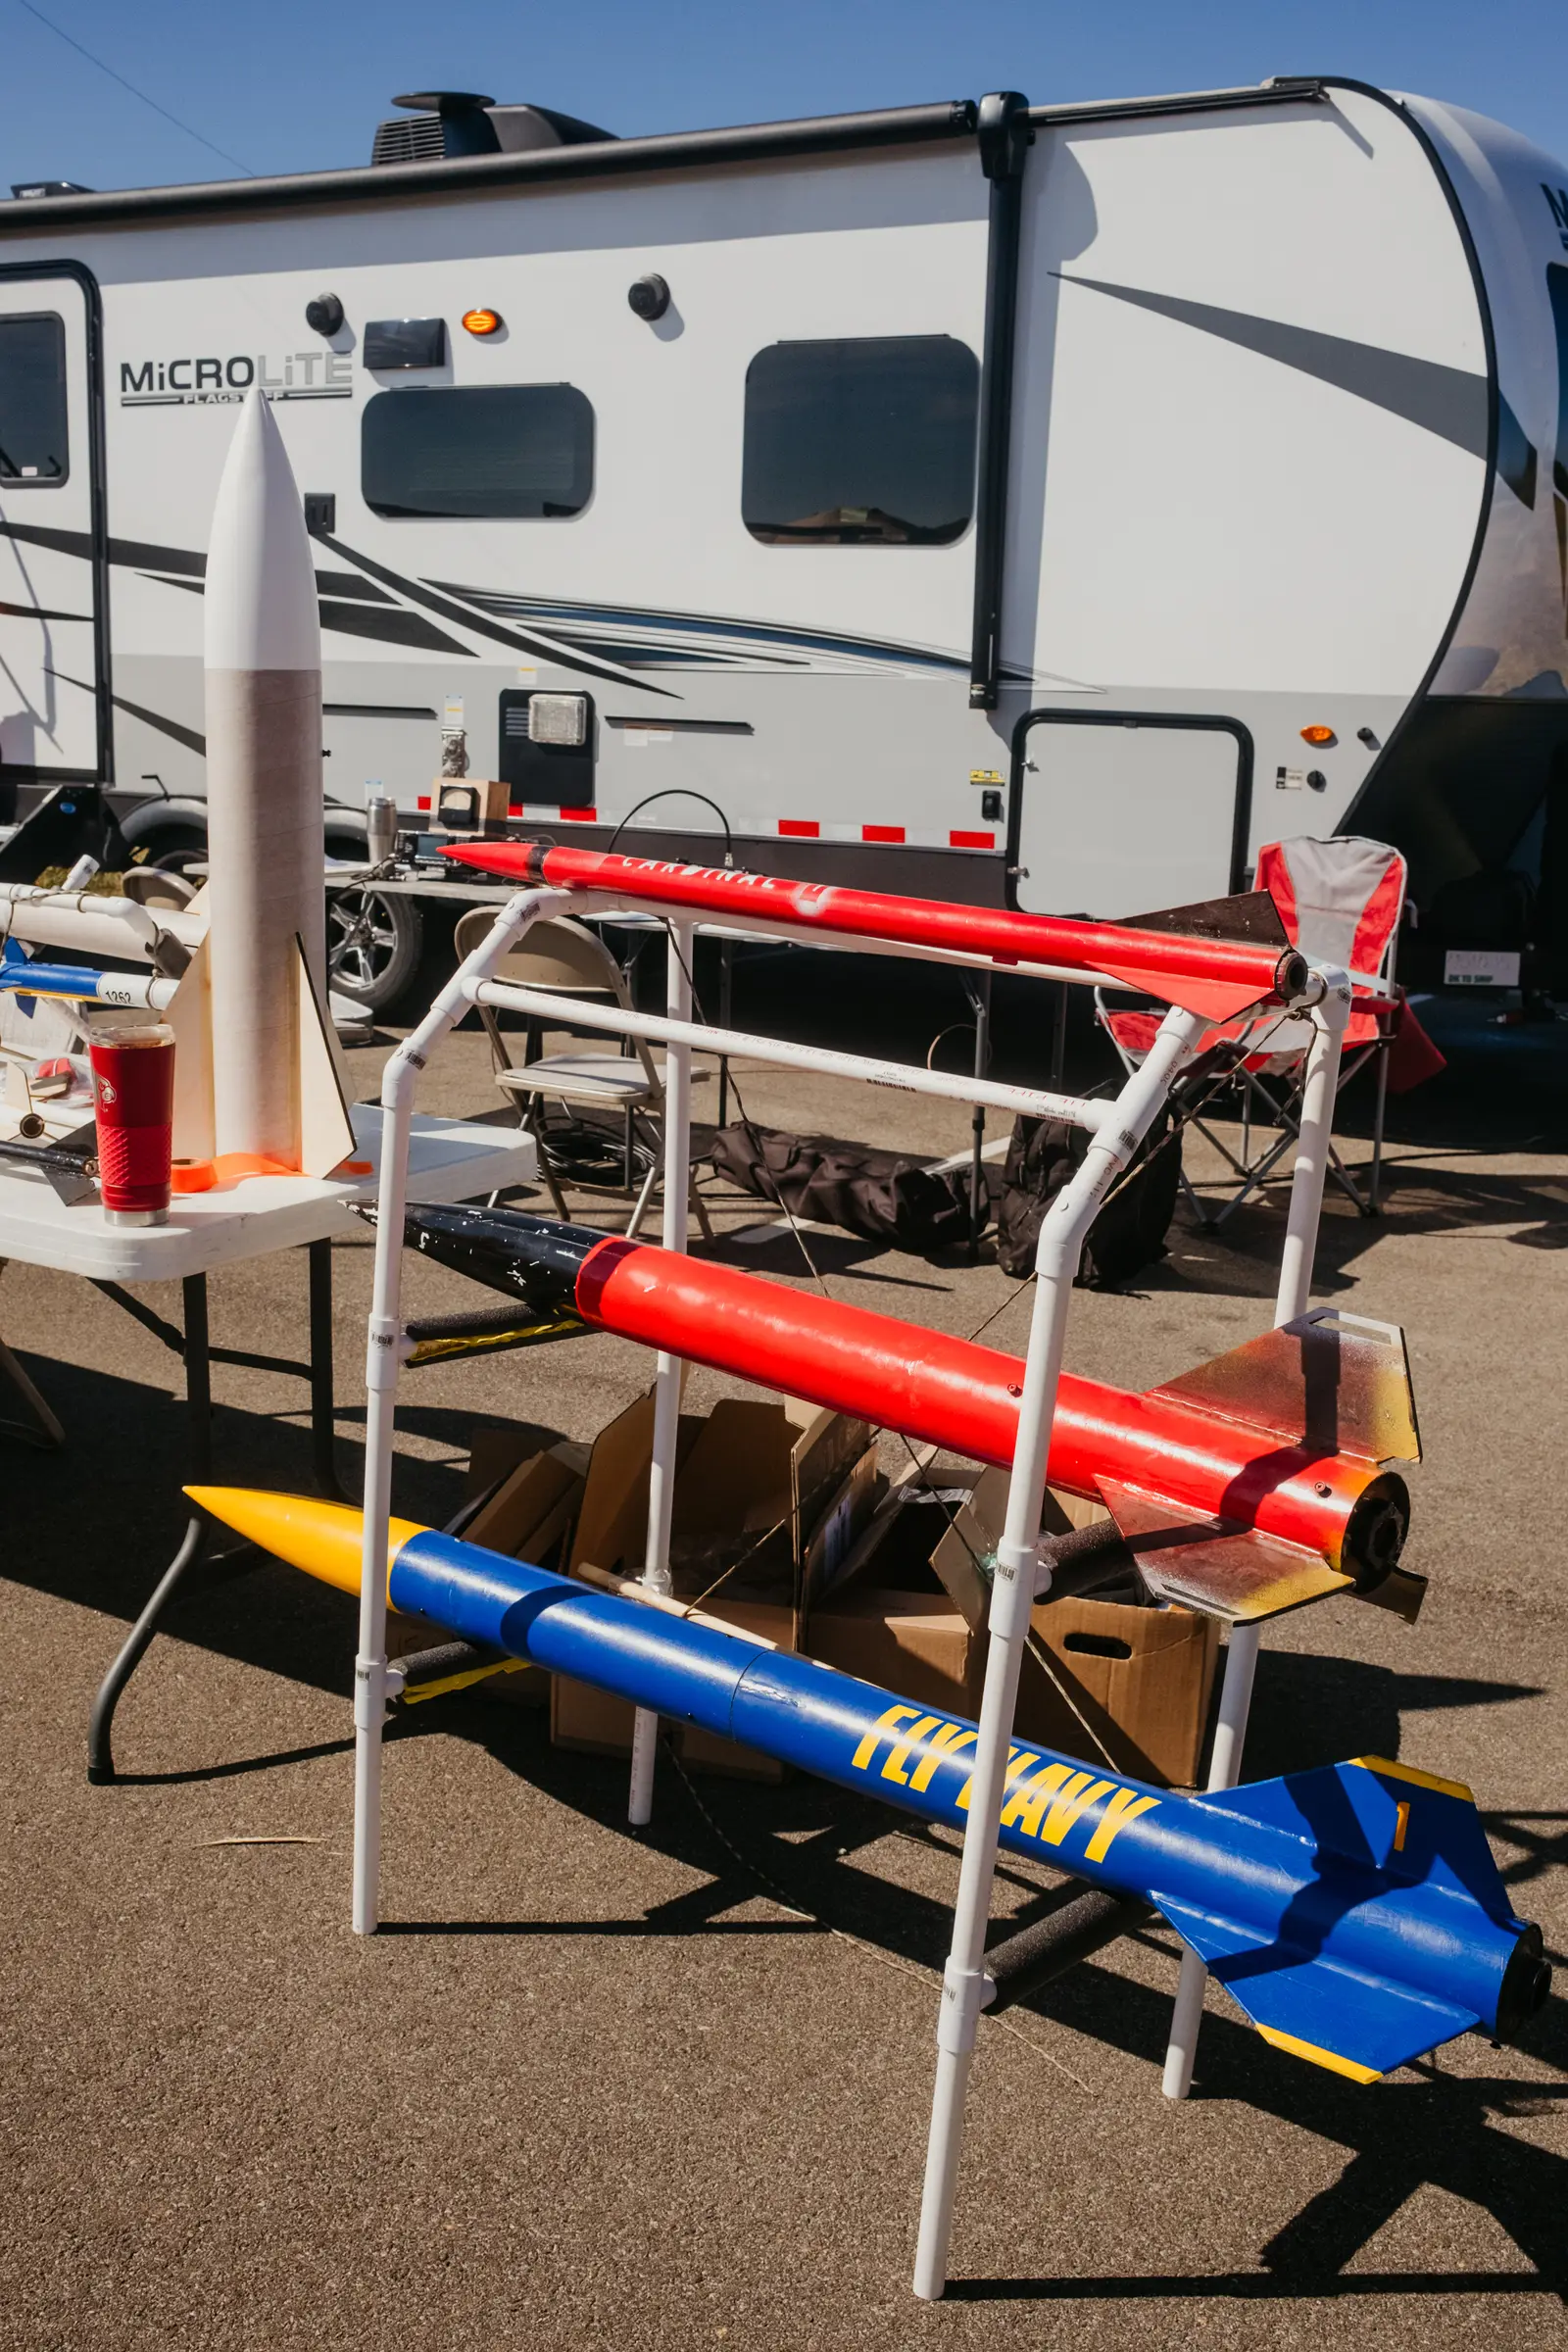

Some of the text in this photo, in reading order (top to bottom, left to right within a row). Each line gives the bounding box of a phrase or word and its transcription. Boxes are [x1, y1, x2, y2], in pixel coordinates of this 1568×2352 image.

[182, 391, 284, 406] FLAGSTFF
[105, 990, 135, 1005] 1262
[852, 1704, 978, 1793] FLY
